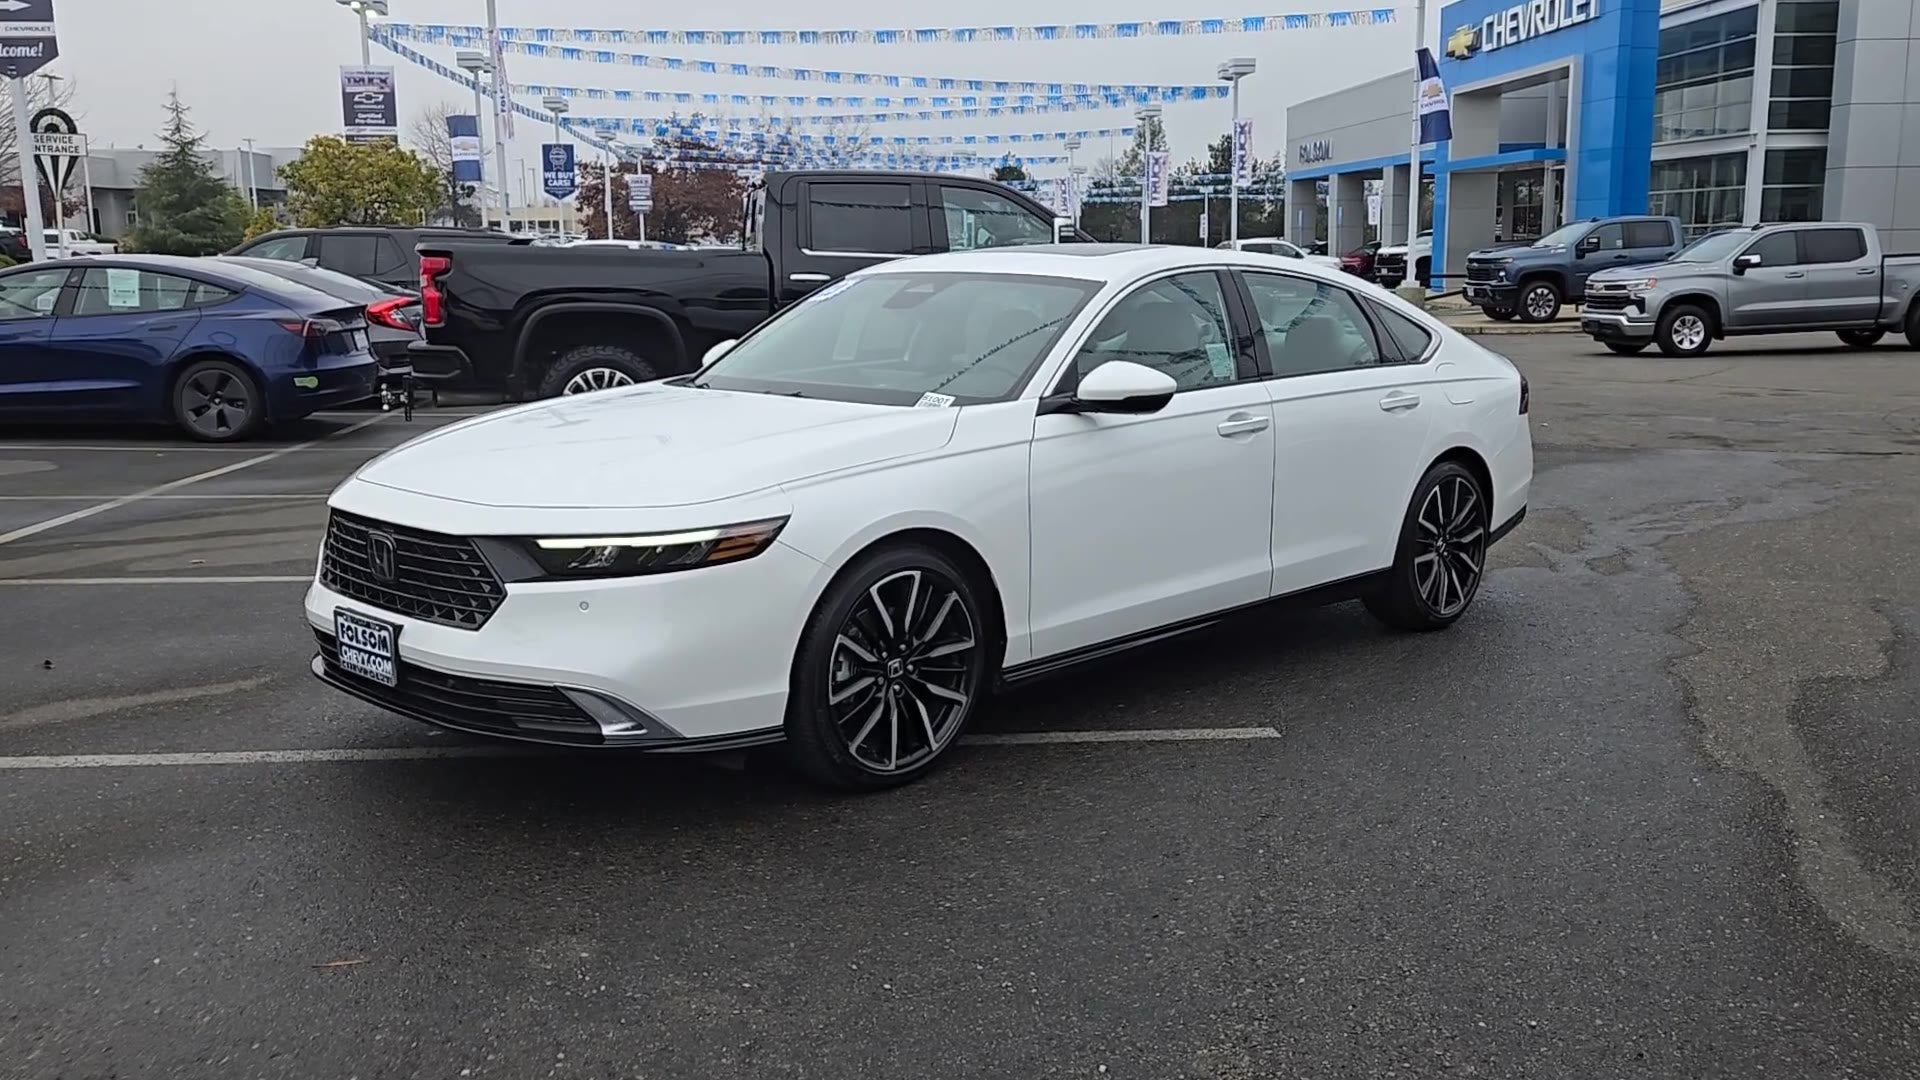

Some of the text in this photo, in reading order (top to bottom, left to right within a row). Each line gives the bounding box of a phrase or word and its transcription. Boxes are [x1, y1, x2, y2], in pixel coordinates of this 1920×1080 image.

[1481, 0, 1600, 52] CHEVROLET
[33, 134, 73, 144] SERVICE
[34, 144, 80, 154] NTRANCE
[1236, 121, 1247, 183] TRUCK
[544, 171, 574, 179] WE BUY
[547, 179, 571, 187] CARS!
[1150, 155, 1161, 204] TRUCK
[340, 622, 389, 653] FOLSOM
[341, 645, 392, 676] CHEVY.COM
